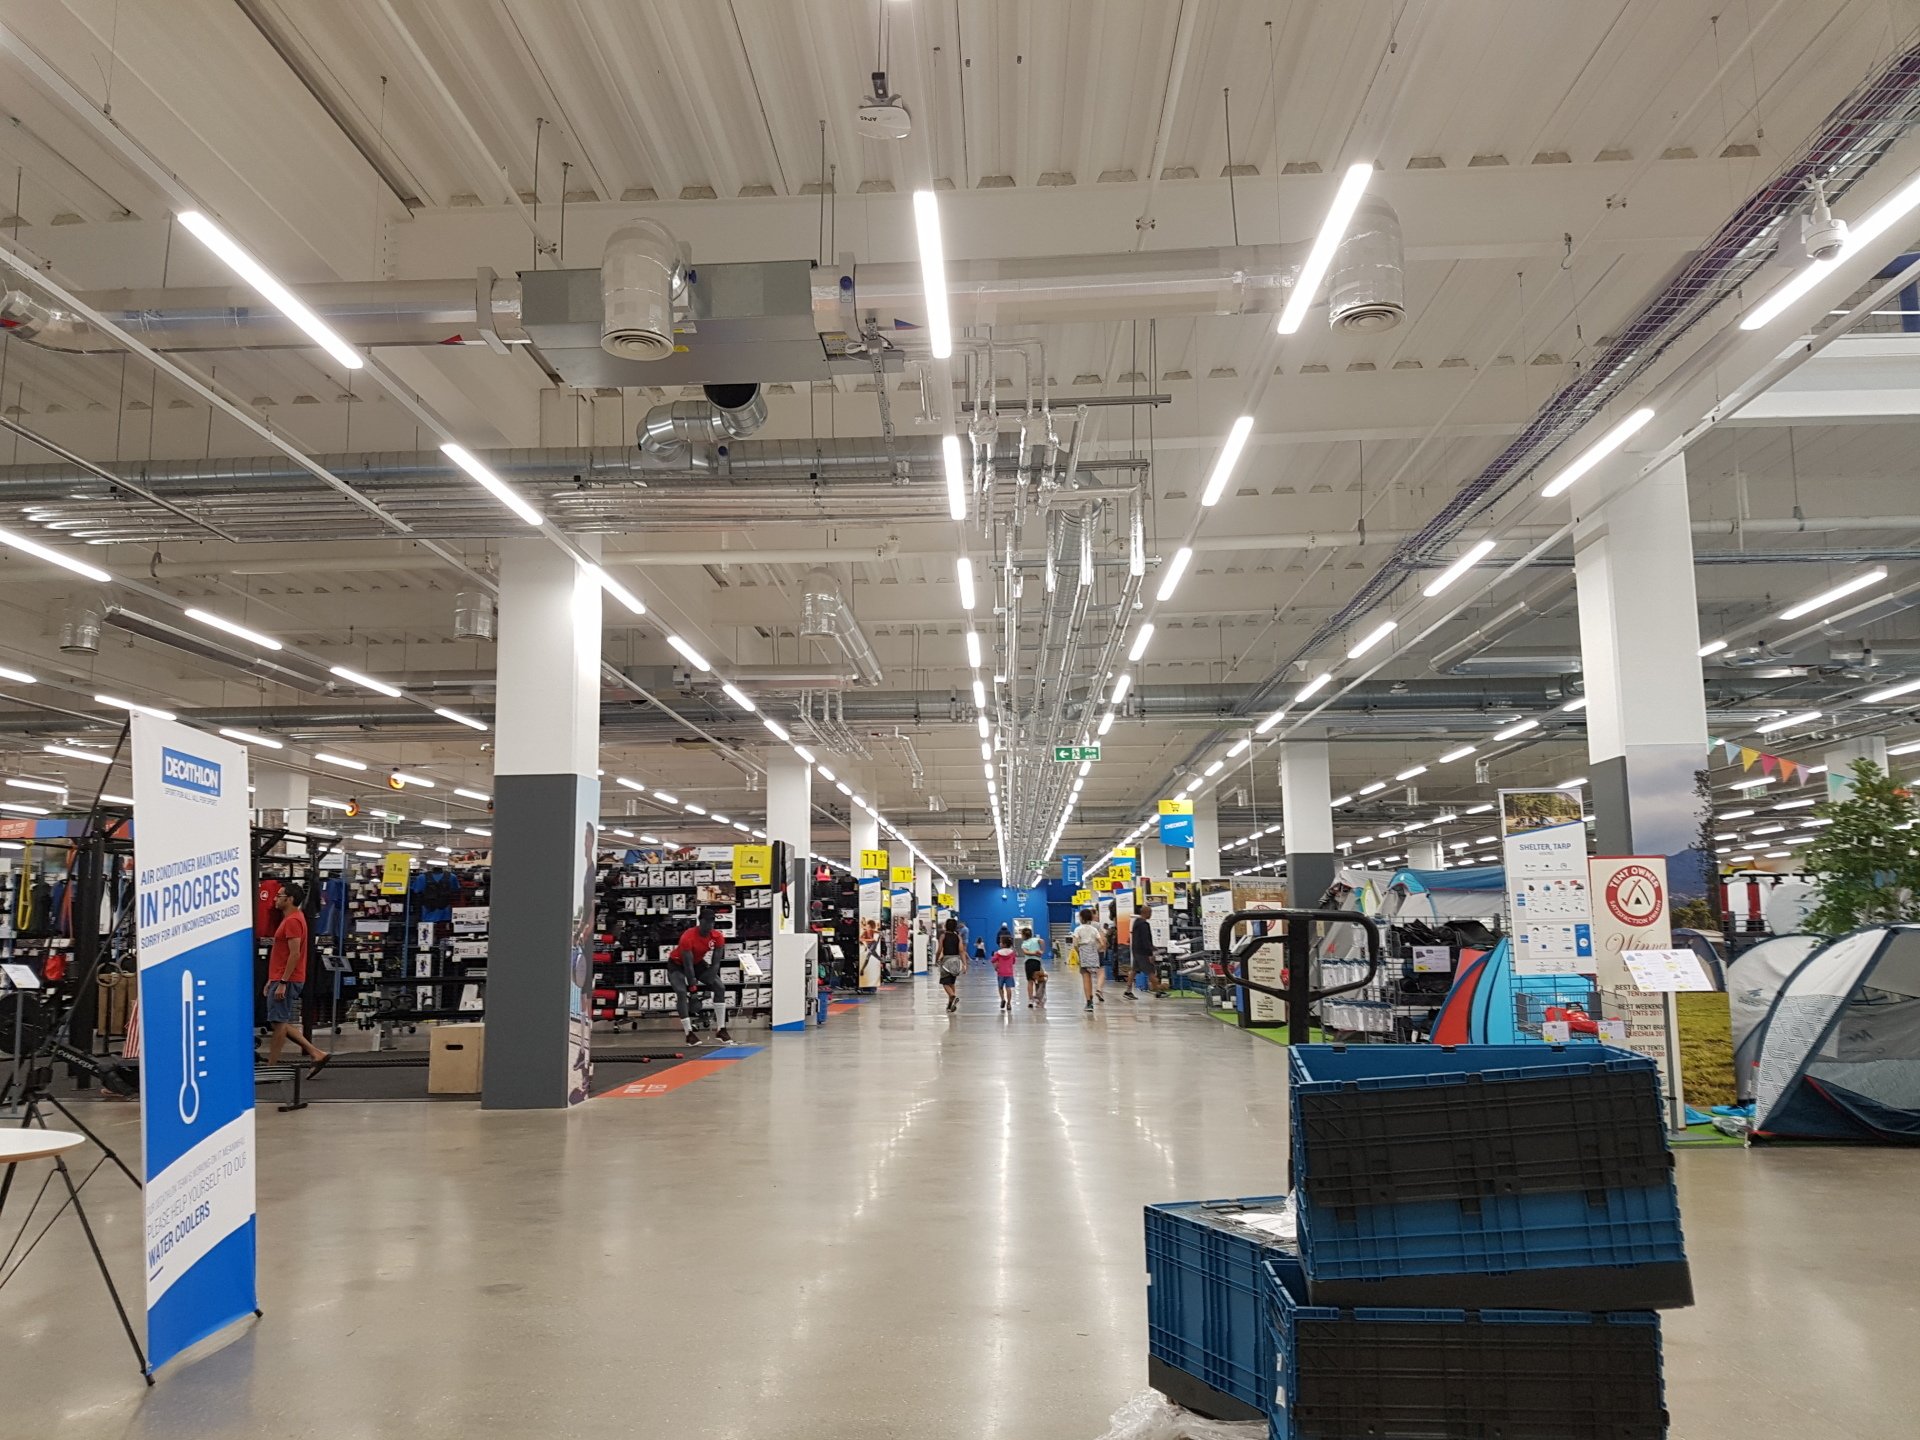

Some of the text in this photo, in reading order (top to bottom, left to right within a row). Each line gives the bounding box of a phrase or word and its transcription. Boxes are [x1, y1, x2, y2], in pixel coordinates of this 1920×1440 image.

[165, 756, 218, 788] DECATHLON
[140, 847, 240, 886] AIR CONDITIONER MAINTENANCE
[1609, 866, 1659, 888] TENT OWNER
[140, 867, 240, 928] IN PROGRESS
[1610, 900, 1648, 924] SATISFACTION
[141, 904, 240, 949] SORRY FOR ANY INCONVENIENCE CAUSED
[1606, 930, 1667, 956] Winner
[189, 1168, 222, 1202] YOURSELF
[223, 1161, 232, 1179] TO
[148, 1200, 210, 1269] WATER COOLERS
